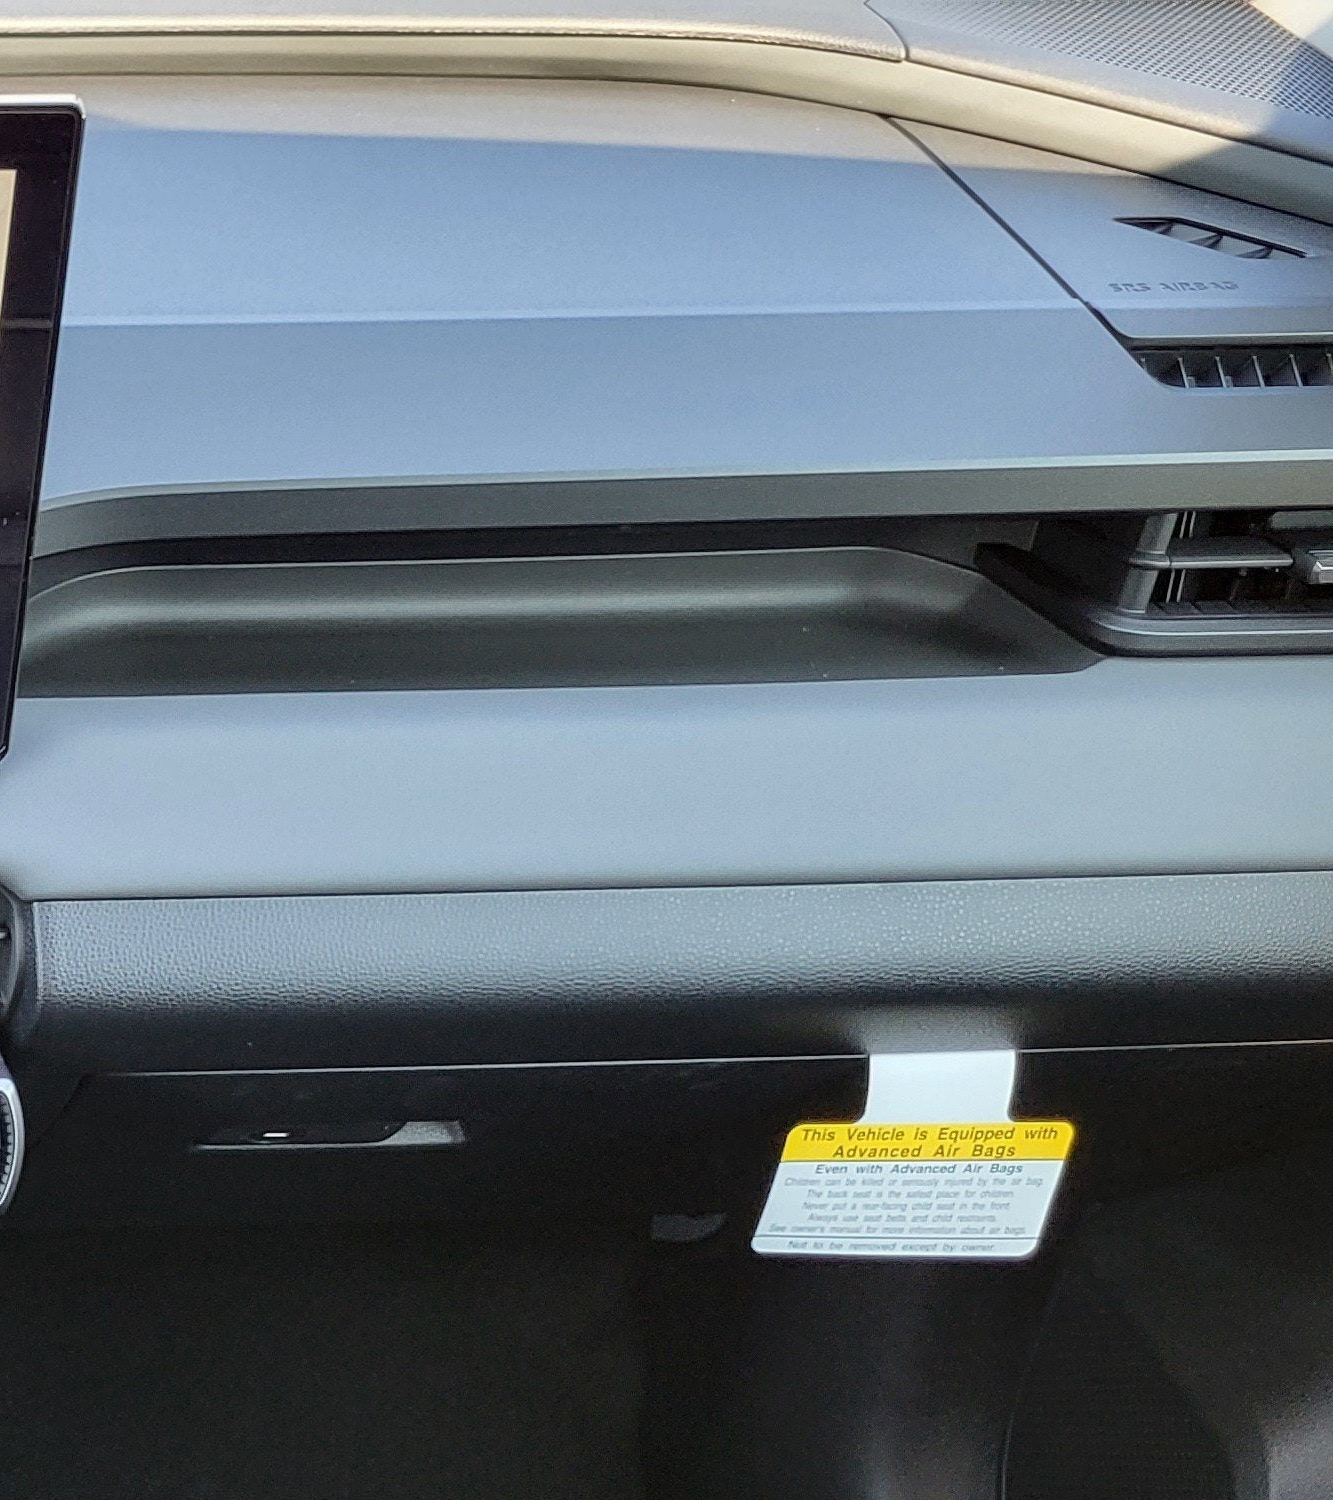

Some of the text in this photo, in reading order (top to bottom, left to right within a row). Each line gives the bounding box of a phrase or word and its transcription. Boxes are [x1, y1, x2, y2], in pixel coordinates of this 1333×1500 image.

[802, 1126, 1058, 1143] This Vehicle is Equipped with
[832, 1144, 1015, 1158] Advanced Air Bags
[815, 1163, 1023, 1175] Even with Advanced Air Bags
